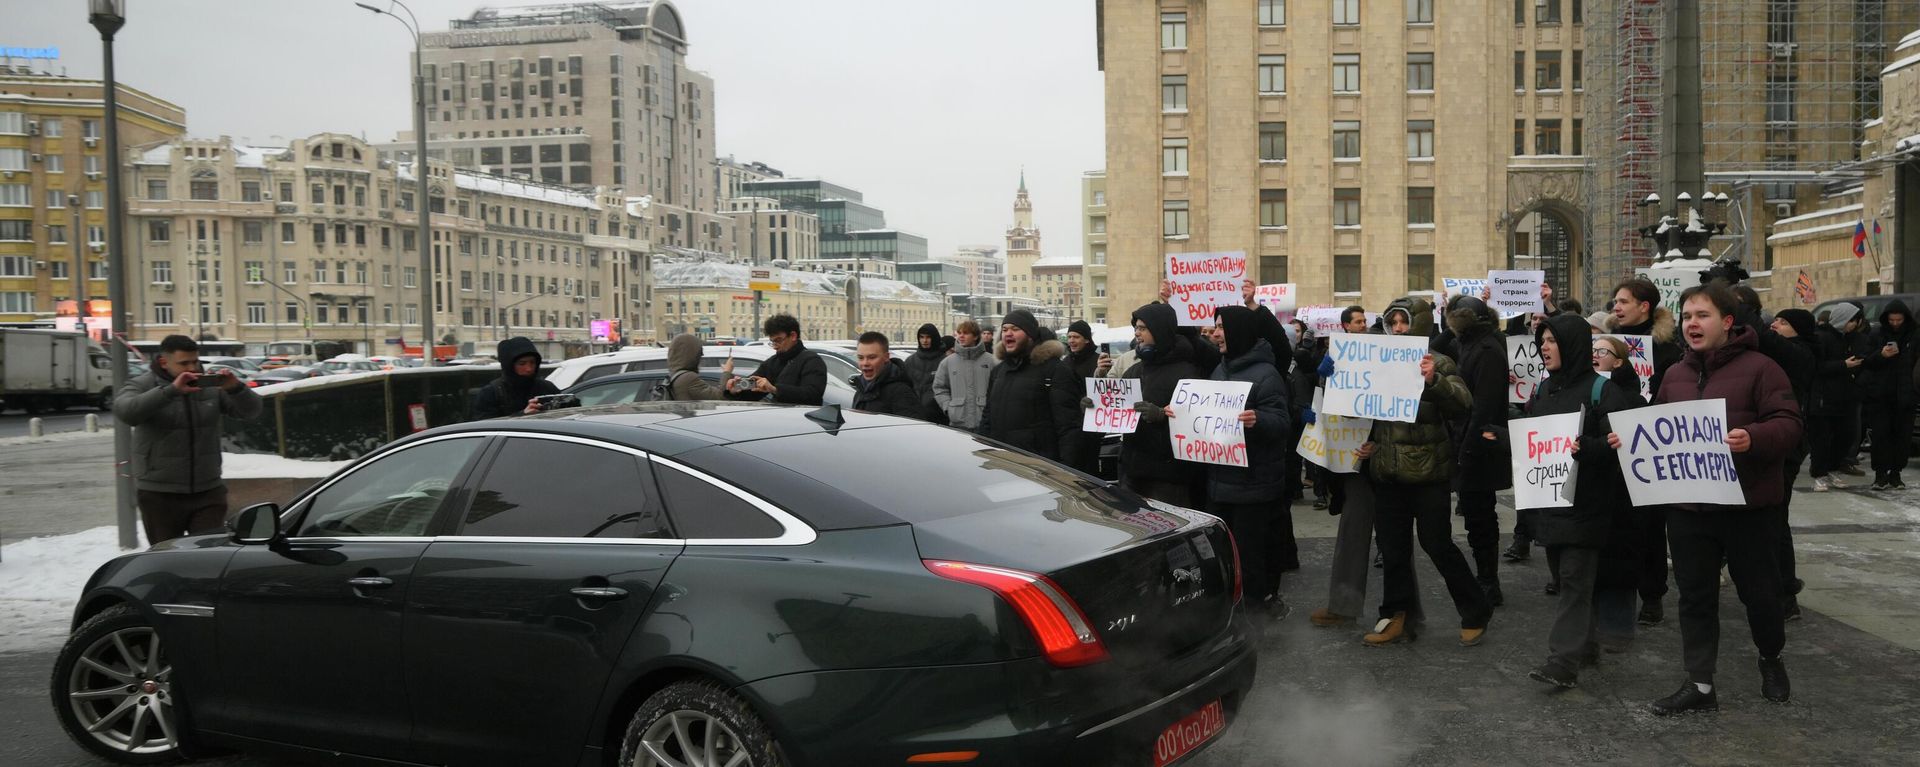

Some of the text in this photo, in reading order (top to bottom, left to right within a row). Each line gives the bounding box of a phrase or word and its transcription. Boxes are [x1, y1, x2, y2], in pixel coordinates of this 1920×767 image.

[1494, 277, 1529, 285] Британия
[1329, 370, 1371, 390] KILLS
[1095, 408, 1138, 430] СМЕРТЬ
[1630, 415, 1724, 455] ЛОНДОН
